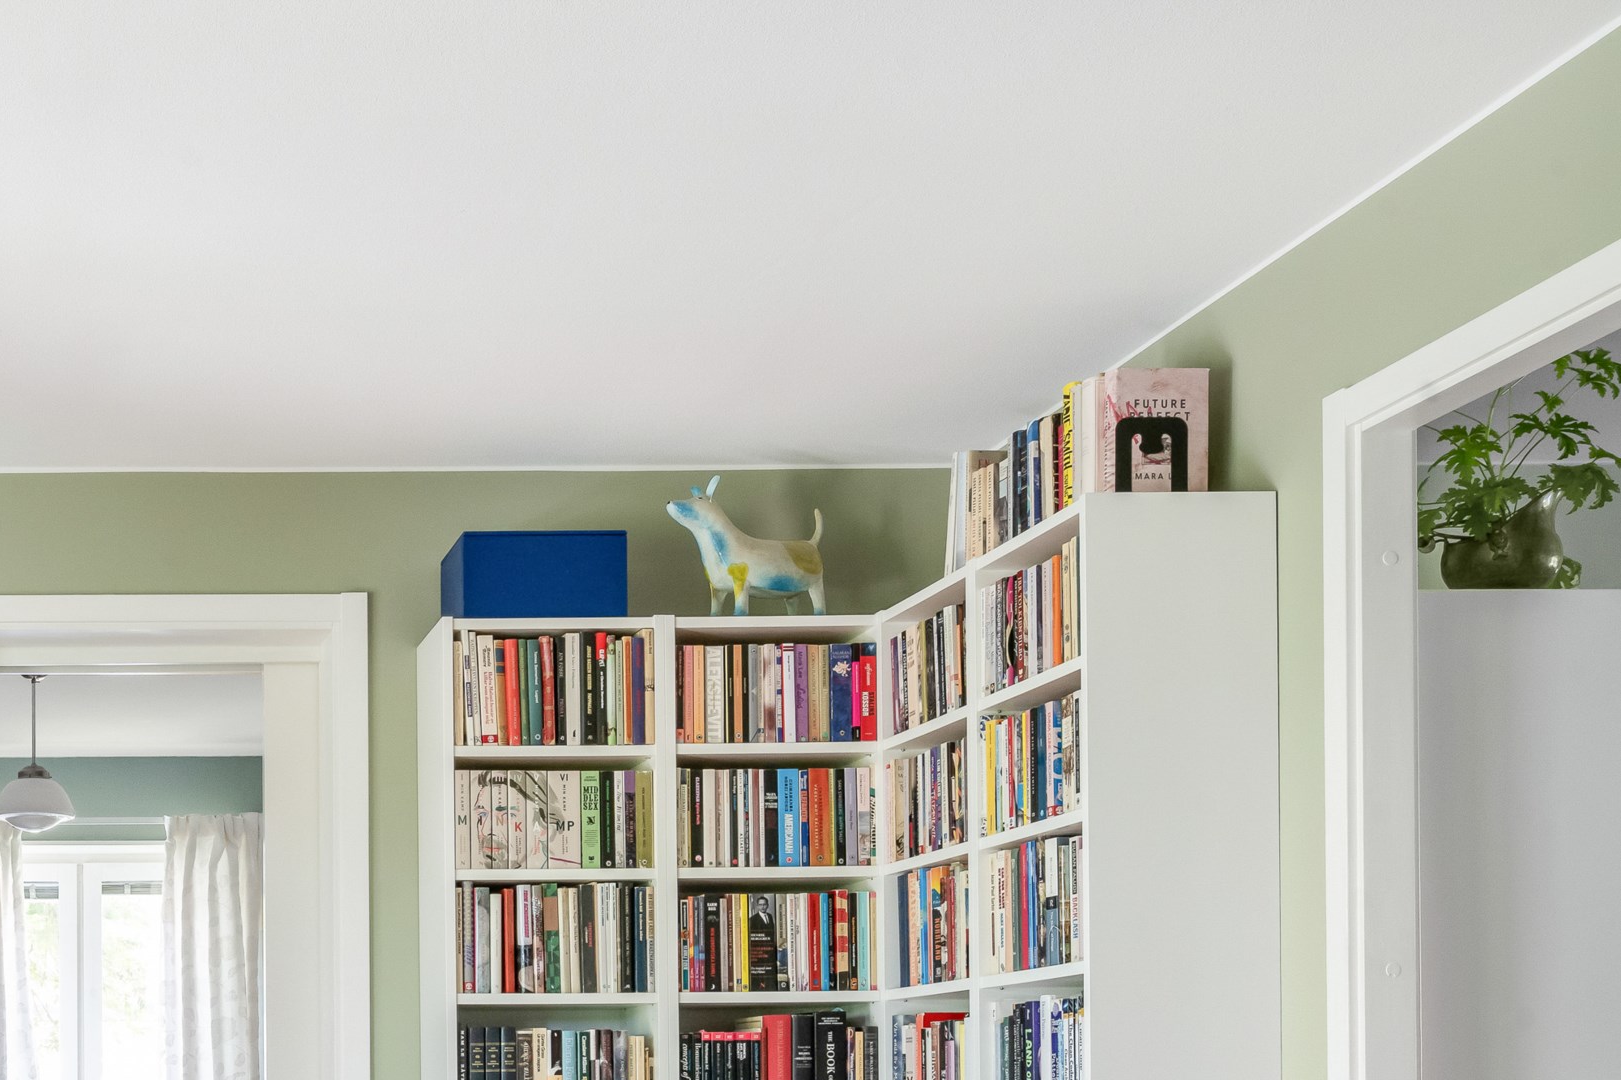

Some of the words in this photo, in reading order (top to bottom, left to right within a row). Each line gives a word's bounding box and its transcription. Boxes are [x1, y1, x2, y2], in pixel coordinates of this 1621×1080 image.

[1134, 399, 1187, 409] FUTURE
[1134, 472, 1160, 480] MARA
[583, 786, 599, 794] MID
[583, 794, 599, 802] DLE
[583, 802, 598, 811] SEX
[458, 815, 467, 825] M
[515, 822, 522, 832] K
[556, 821, 575, 831] MP
[784, 814, 793, 854] AMERICANAH
[565, 1037, 574, 1064] Elena
[681, 1043, 689, 1071] concepts
[826, 1043, 835, 1074] BOOK
[681, 1071, 691, 1080] of
